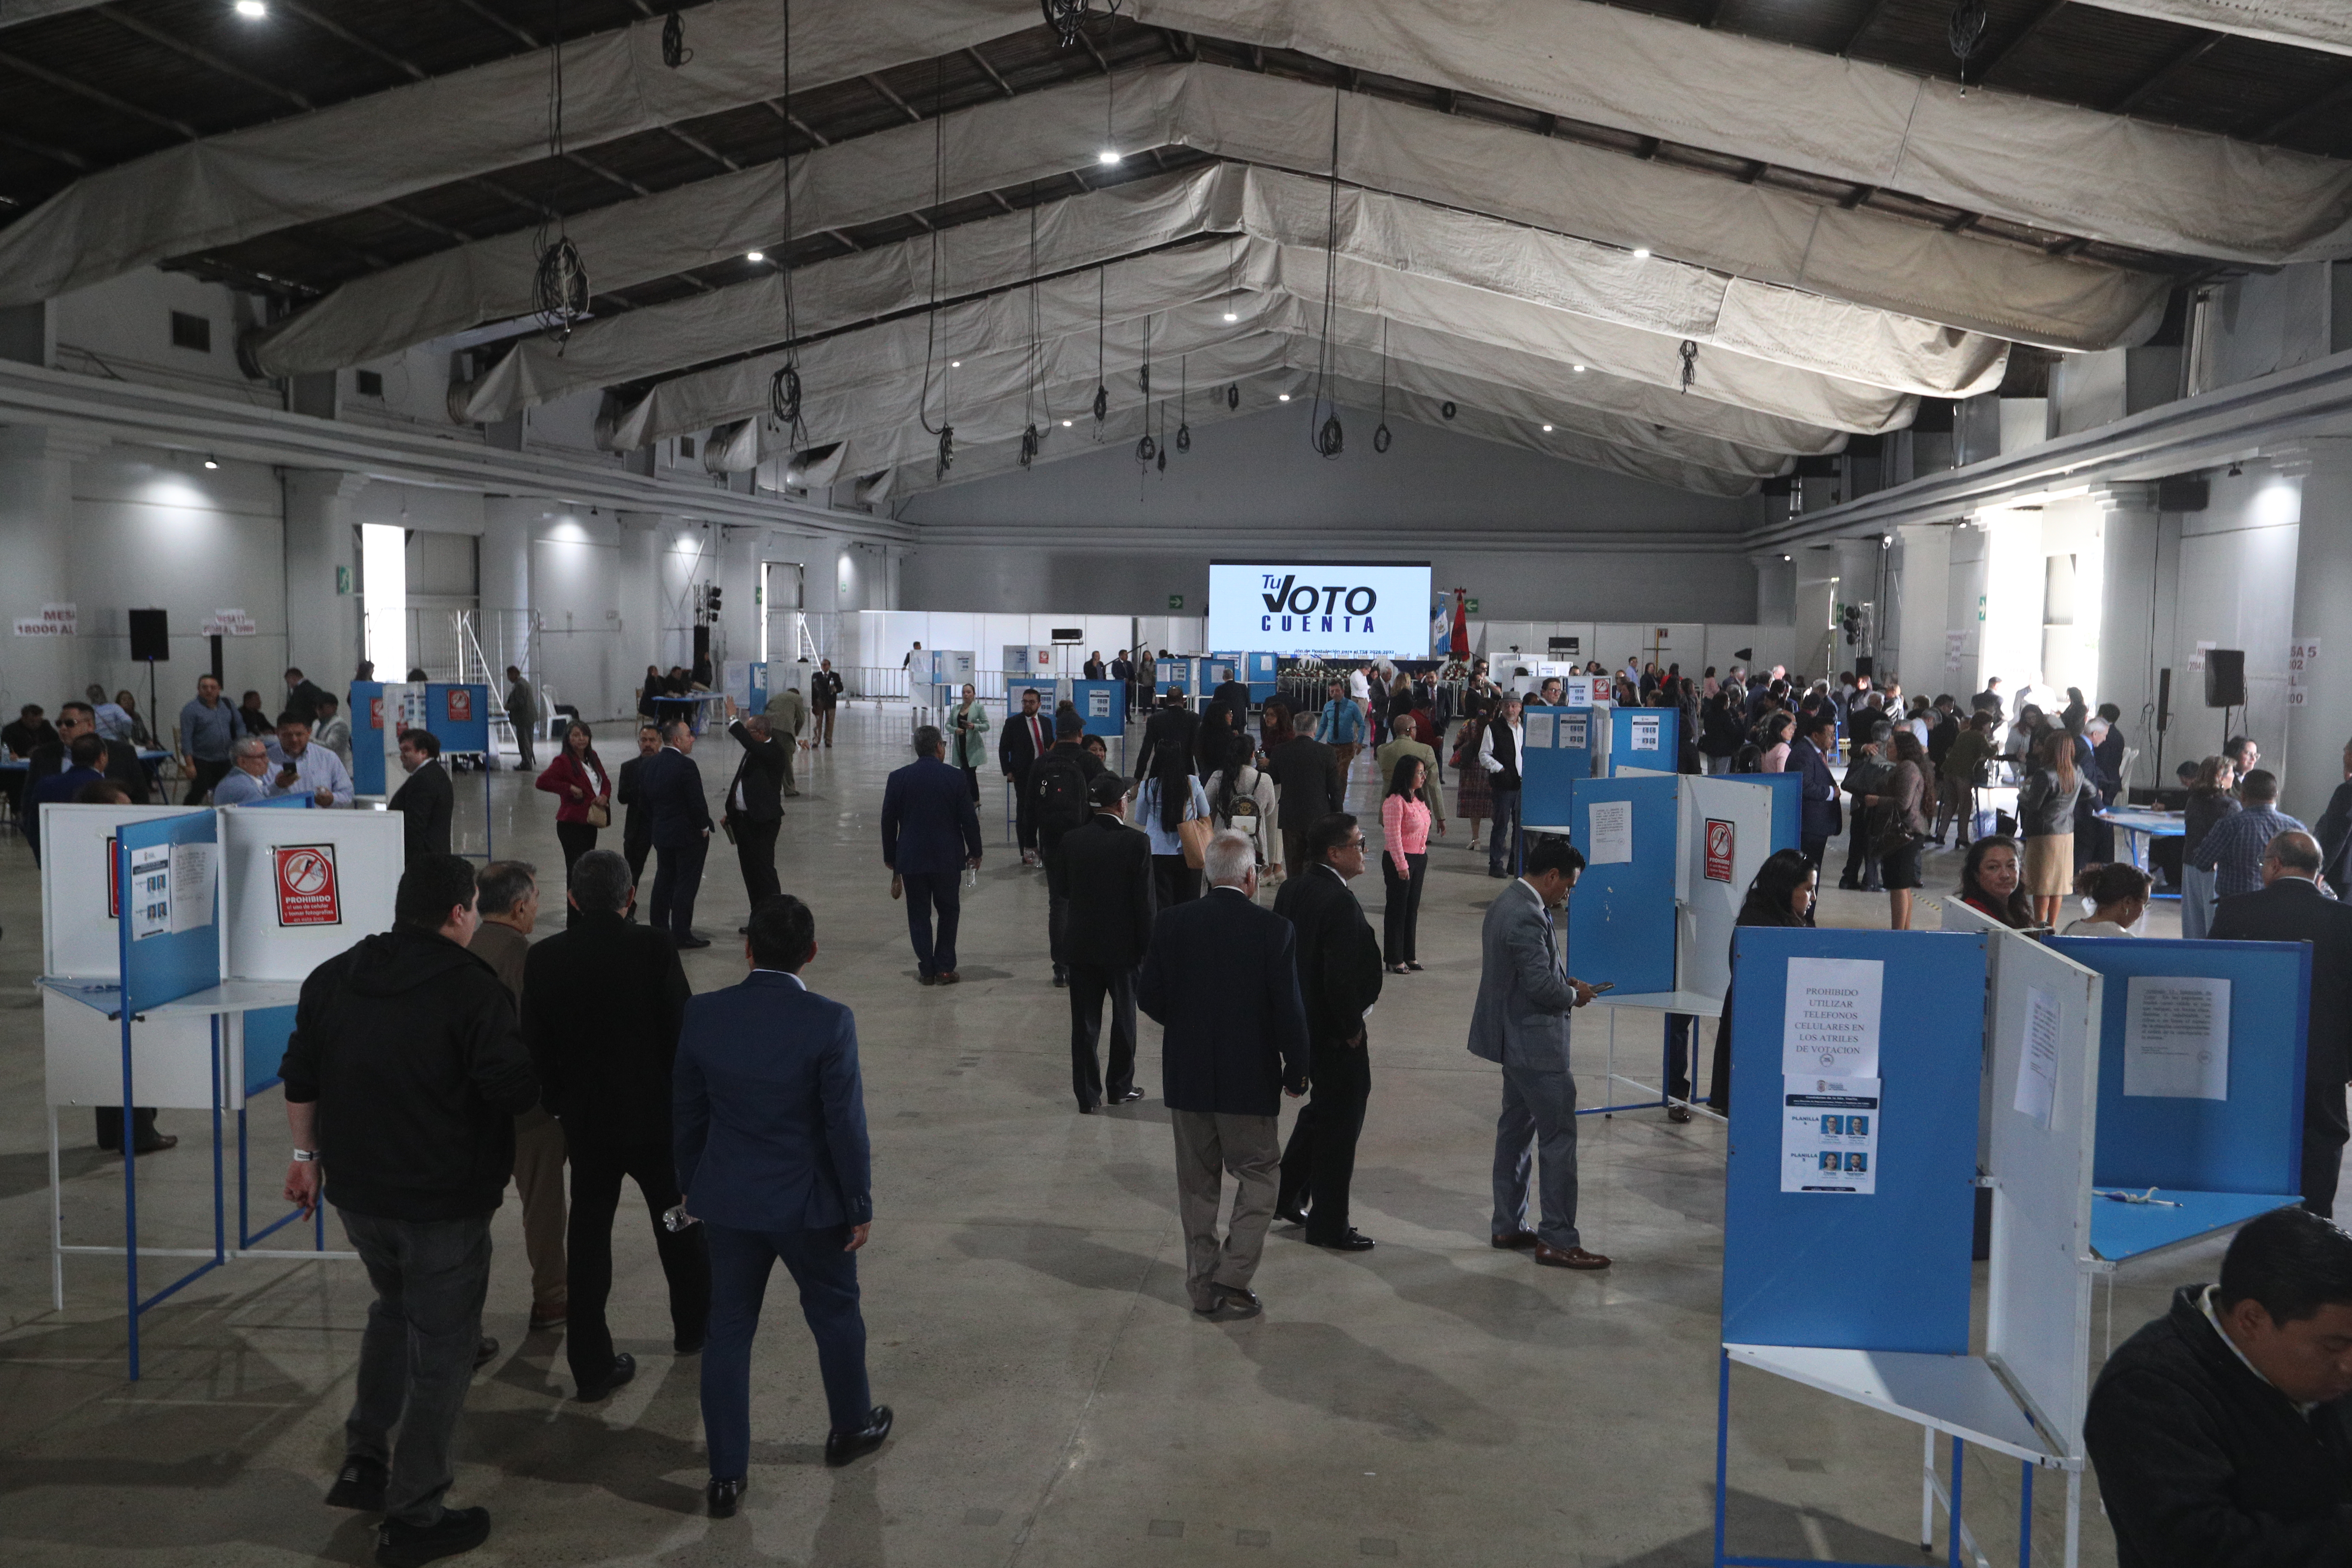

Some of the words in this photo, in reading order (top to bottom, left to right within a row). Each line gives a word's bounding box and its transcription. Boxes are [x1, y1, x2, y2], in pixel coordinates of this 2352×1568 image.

[1262, 574, 1281, 589] Tu
[1262, 575, 1377, 616] VOTO
[44, 610, 75, 621] MES
[1262, 615, 1374, 633] CUENTA
[2307, 646, 2317, 658] 5
[2289, 659, 2303, 670] 02
[285, 895, 331, 904] PROHIBIDO
[1806, 988, 1858, 996] PROHIBIDO
[1809, 999, 1853, 1008] UTILIZAR
[1804, 1011, 1858, 1020] TELEFONOS
[1795, 1022, 1850, 1031] CELULARES
